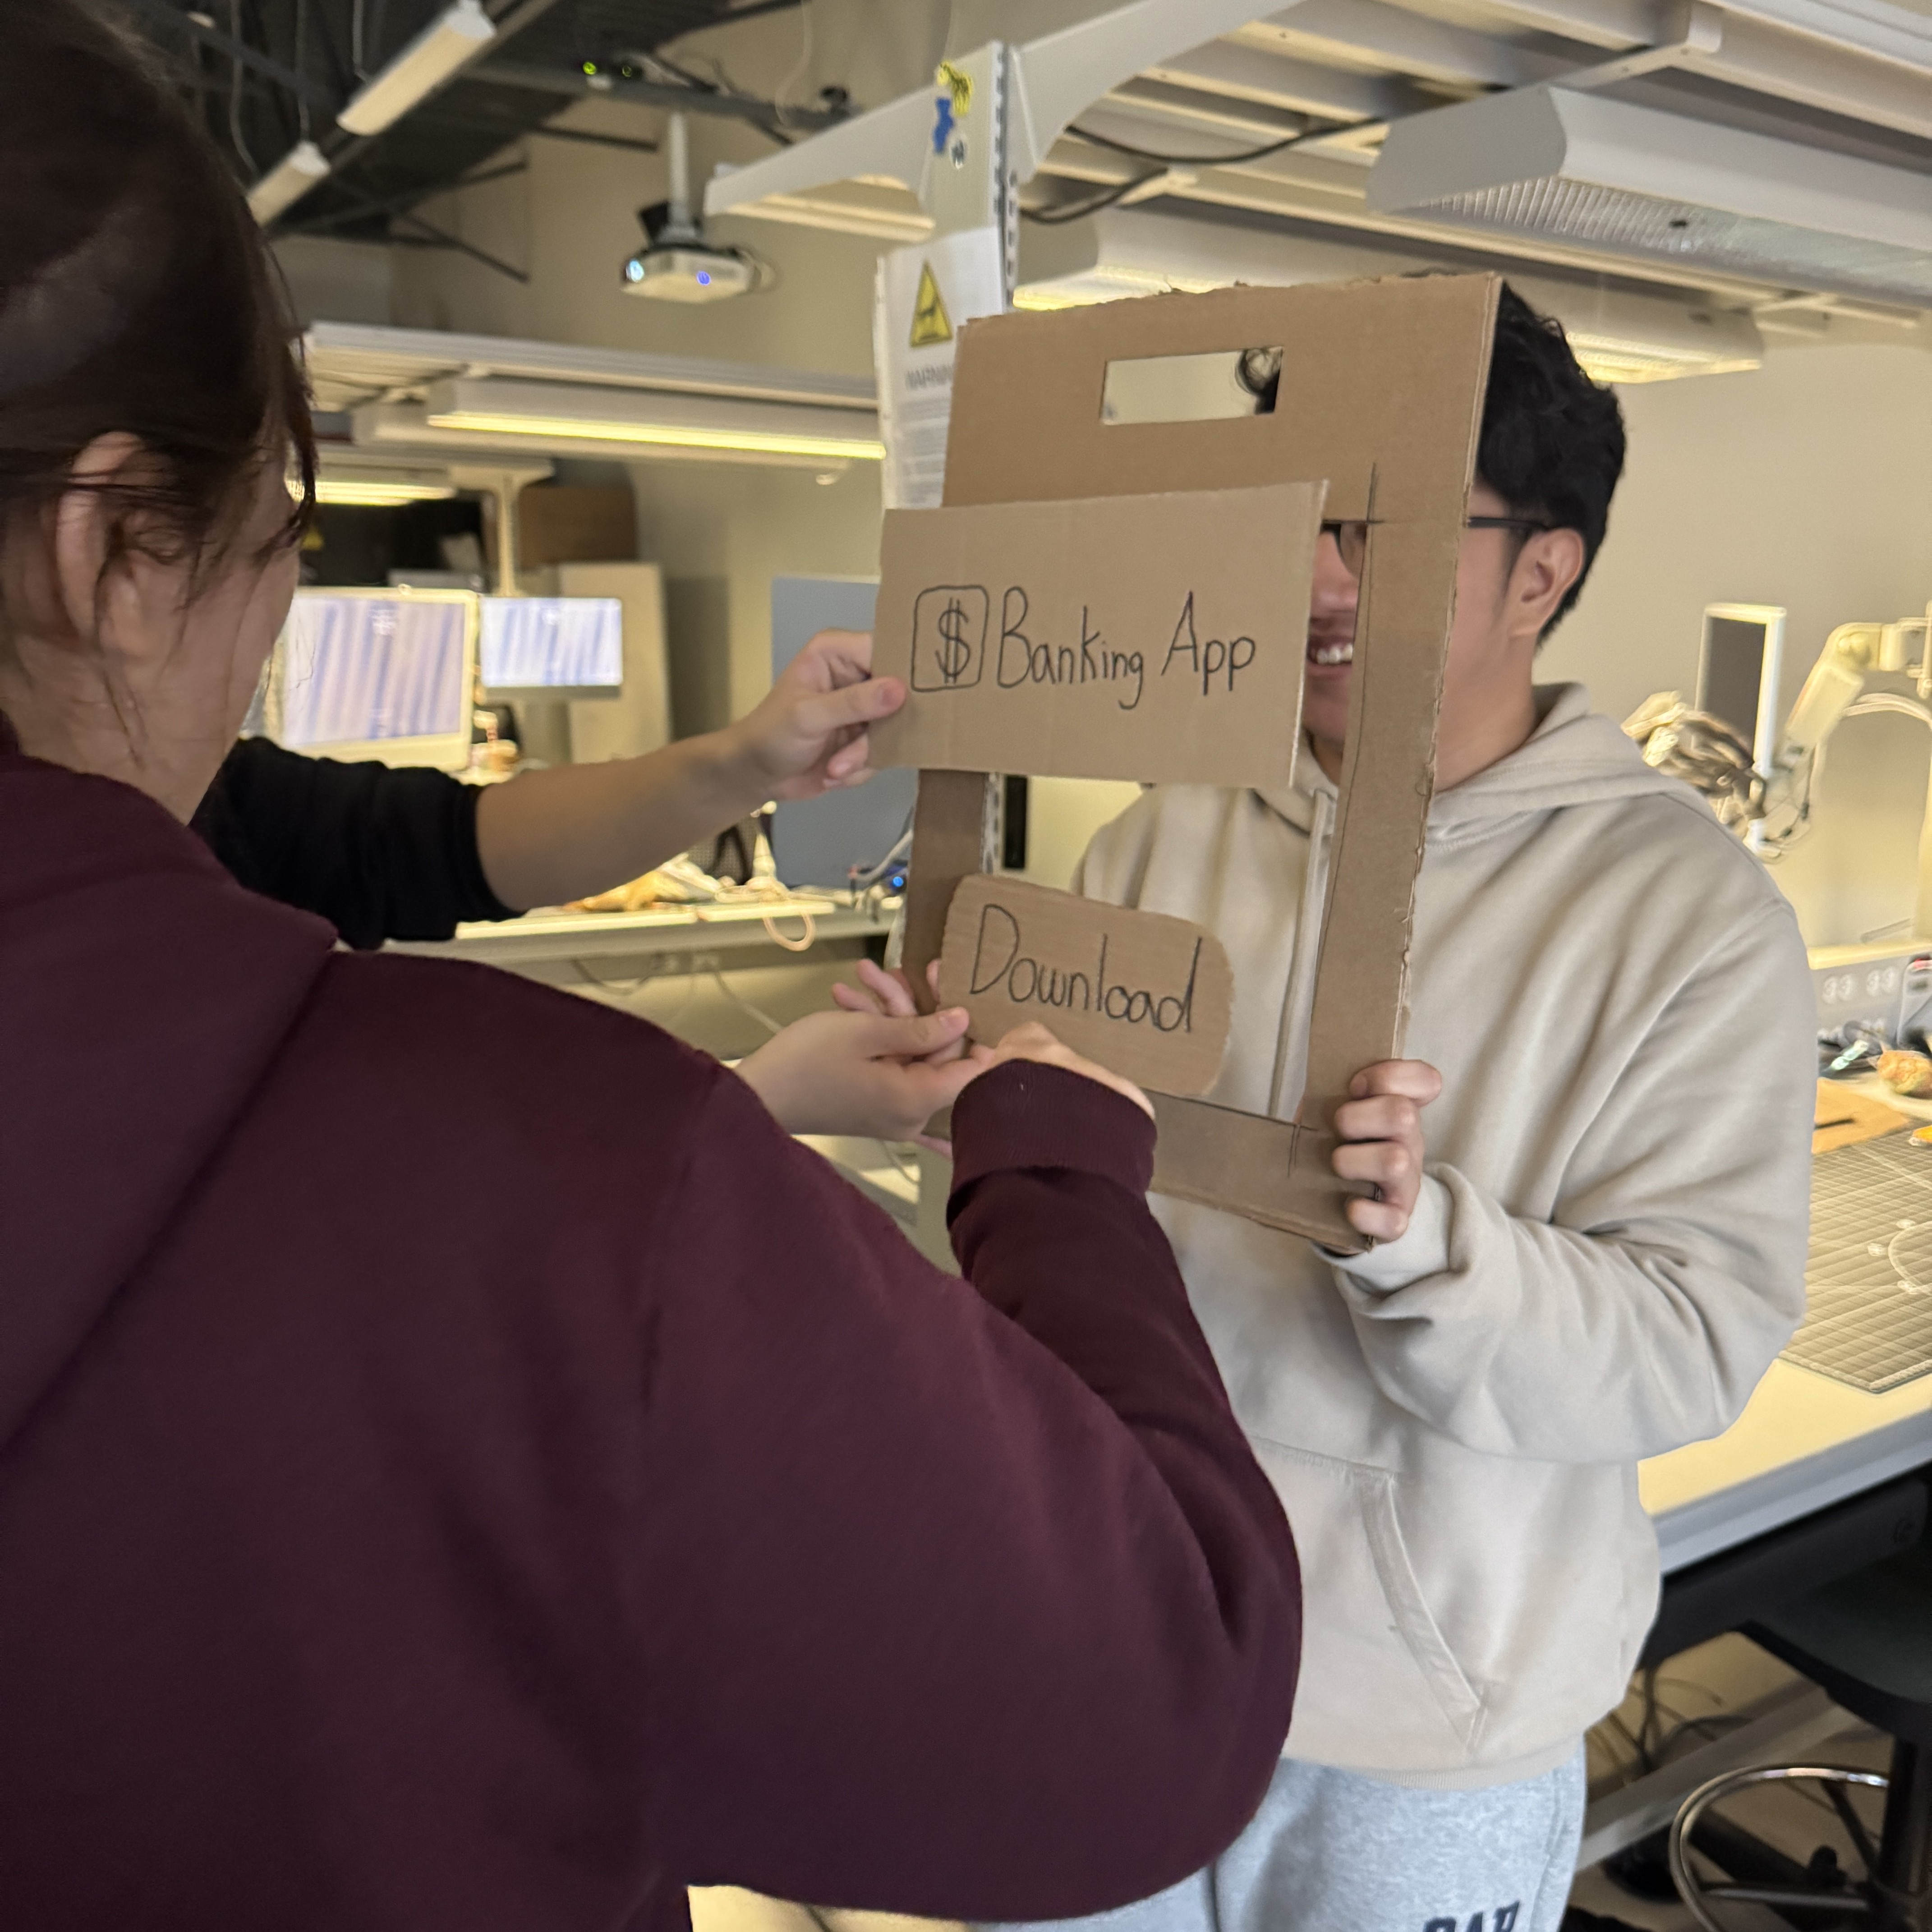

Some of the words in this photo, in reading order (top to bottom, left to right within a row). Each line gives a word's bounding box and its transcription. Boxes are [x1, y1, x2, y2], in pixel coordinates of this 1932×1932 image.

[997, 586, 1144, 710] Banking
[1161, 590, 1256, 696] App
[969, 903, 1203, 1033] Download
